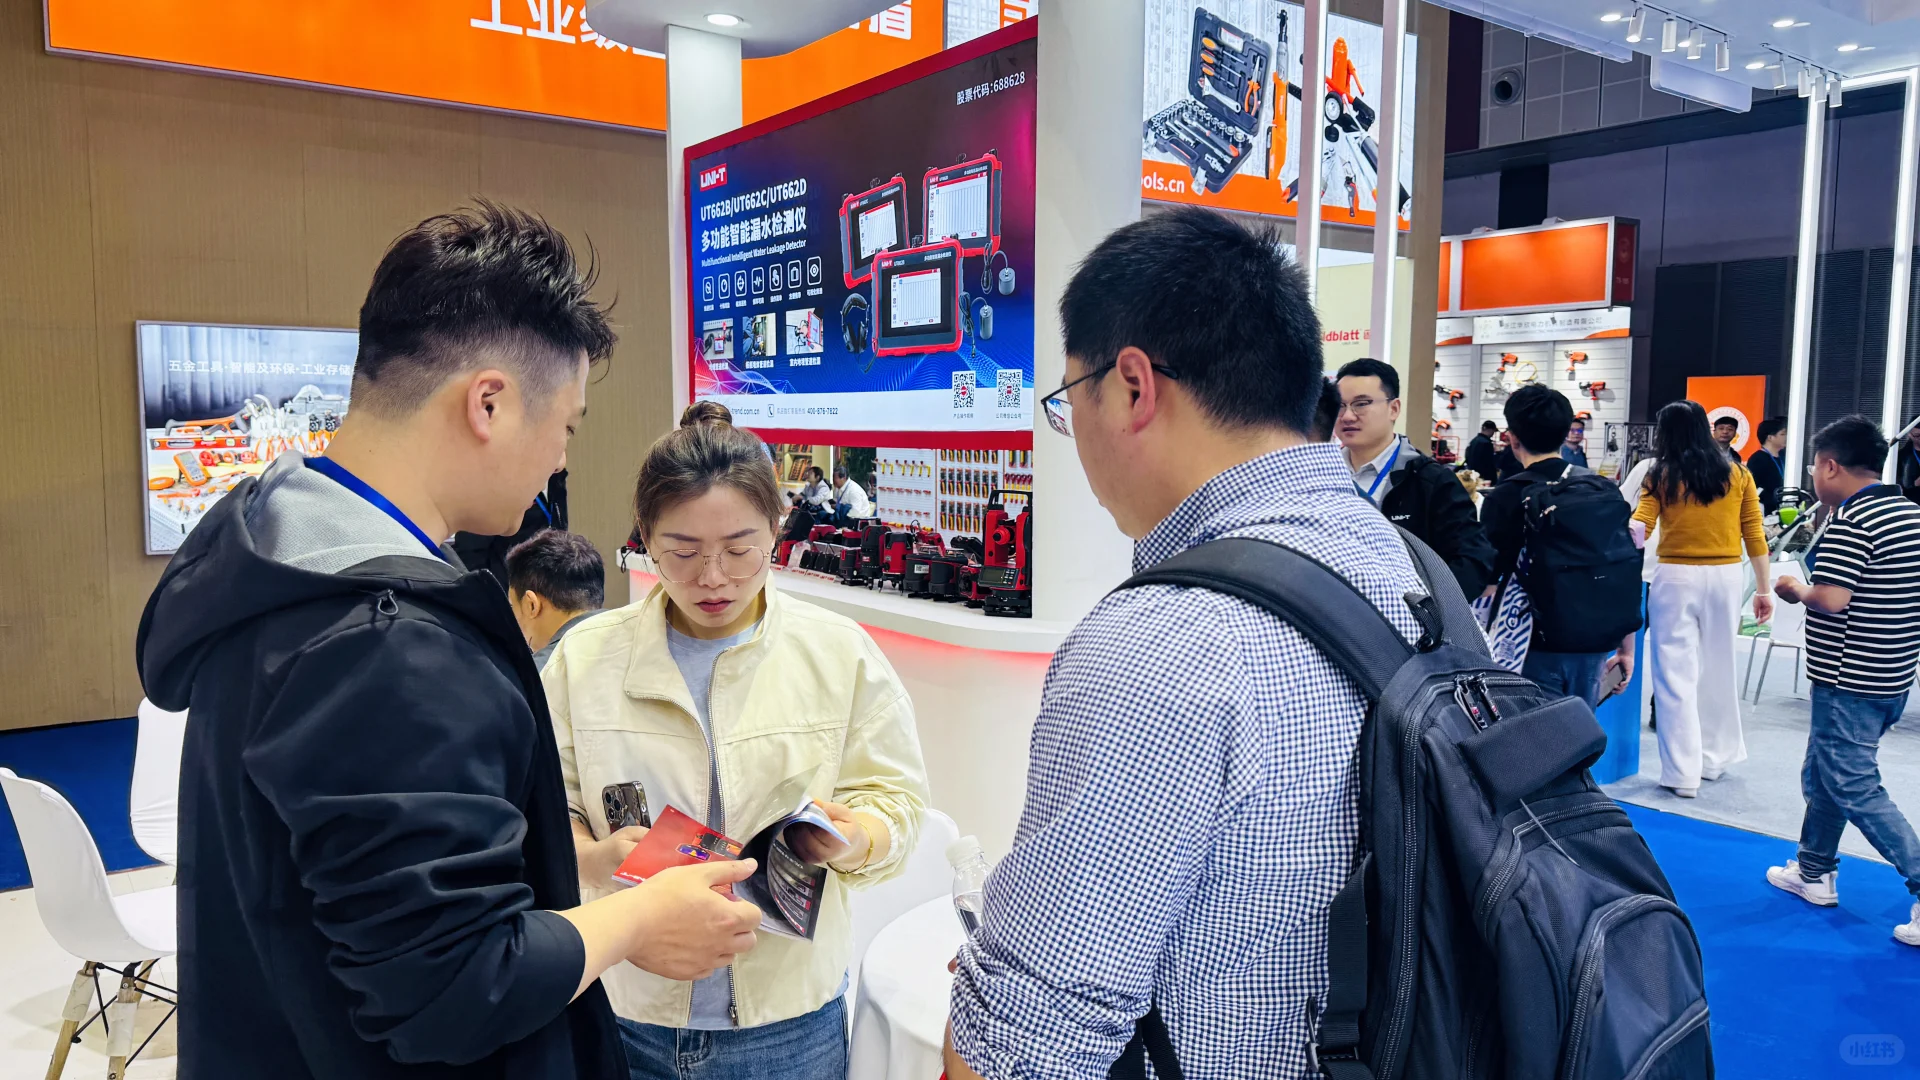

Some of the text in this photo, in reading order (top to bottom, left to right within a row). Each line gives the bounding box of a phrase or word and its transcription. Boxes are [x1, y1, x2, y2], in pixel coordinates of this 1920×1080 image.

[956, 71, 1026, 105] 股票代码:688628
[701, 167, 726, 188] UNI-T
[1141, 171, 1185, 194] ols.cn
[700, 178, 807, 221] UT662B/UT662C/UT662D
[701, 206, 807, 252] 多功能智能漏水检测仪
[701, 239, 807, 267] Multifunctional Intelligent Water Leakage Detector
